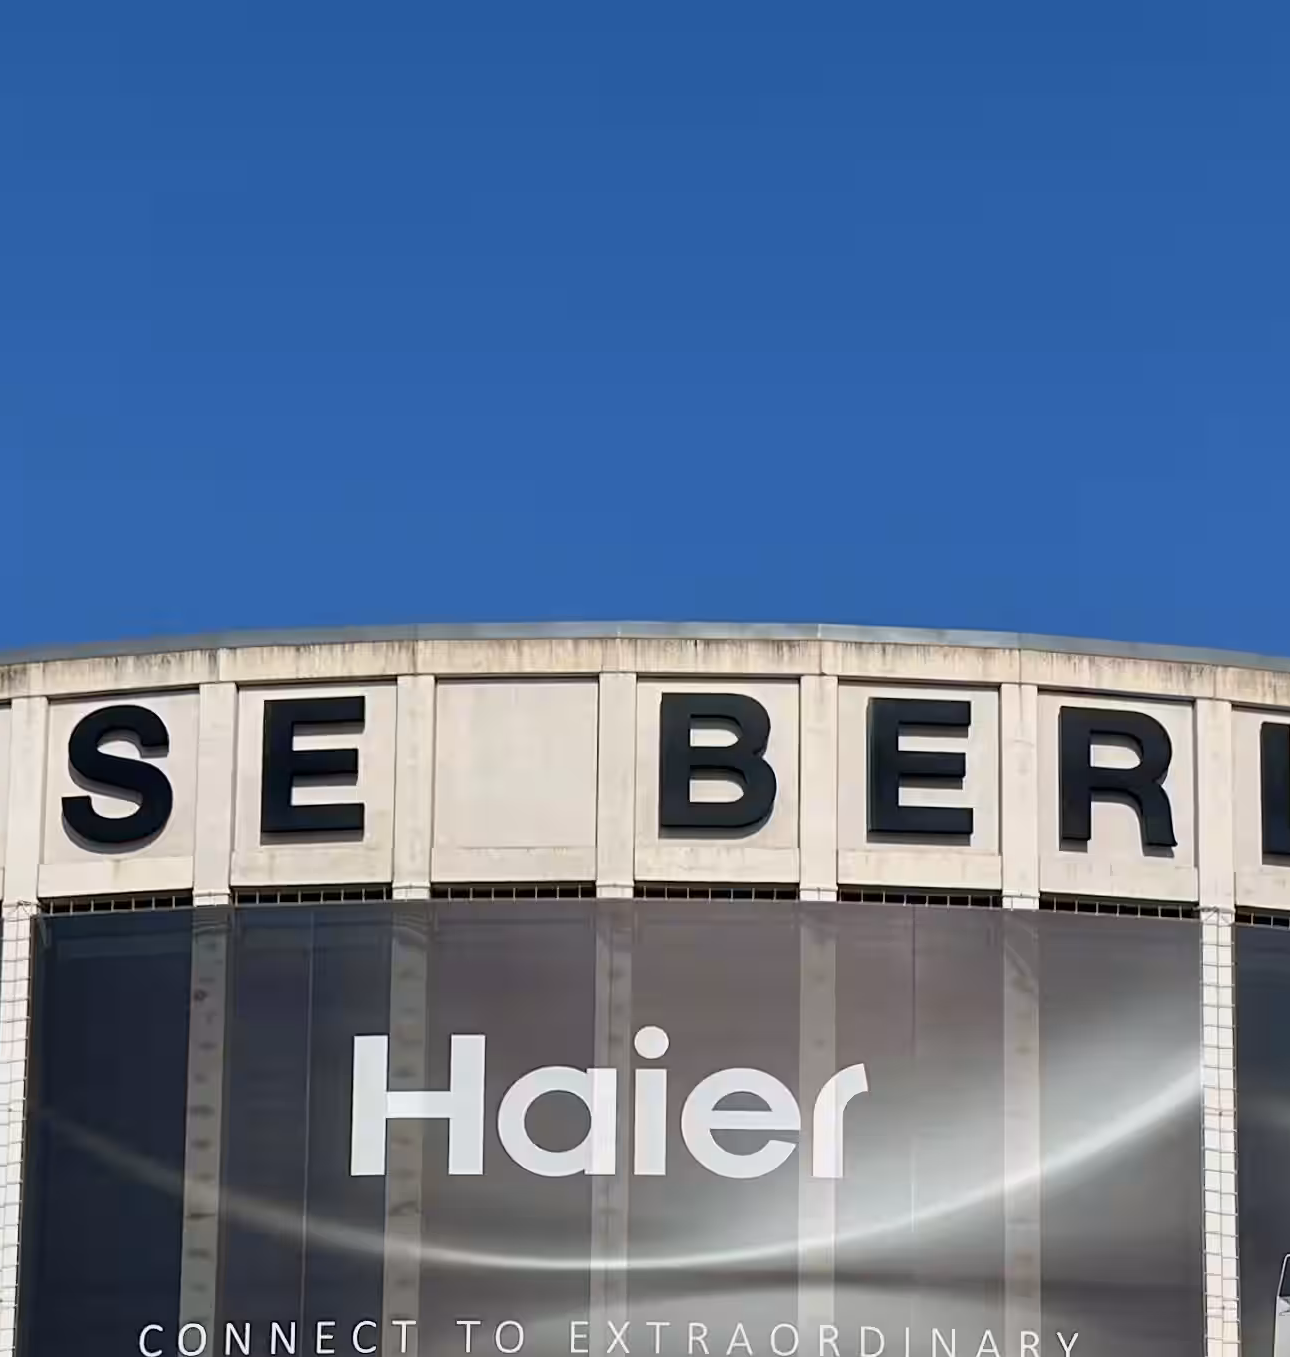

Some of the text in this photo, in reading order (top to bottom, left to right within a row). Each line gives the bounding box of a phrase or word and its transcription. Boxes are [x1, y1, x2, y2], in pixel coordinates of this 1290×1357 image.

[350, 1025, 869, 1179] Haier
[138, 1318, 422, 1357] CONNECT
[456, 1318, 526, 1356] TO
